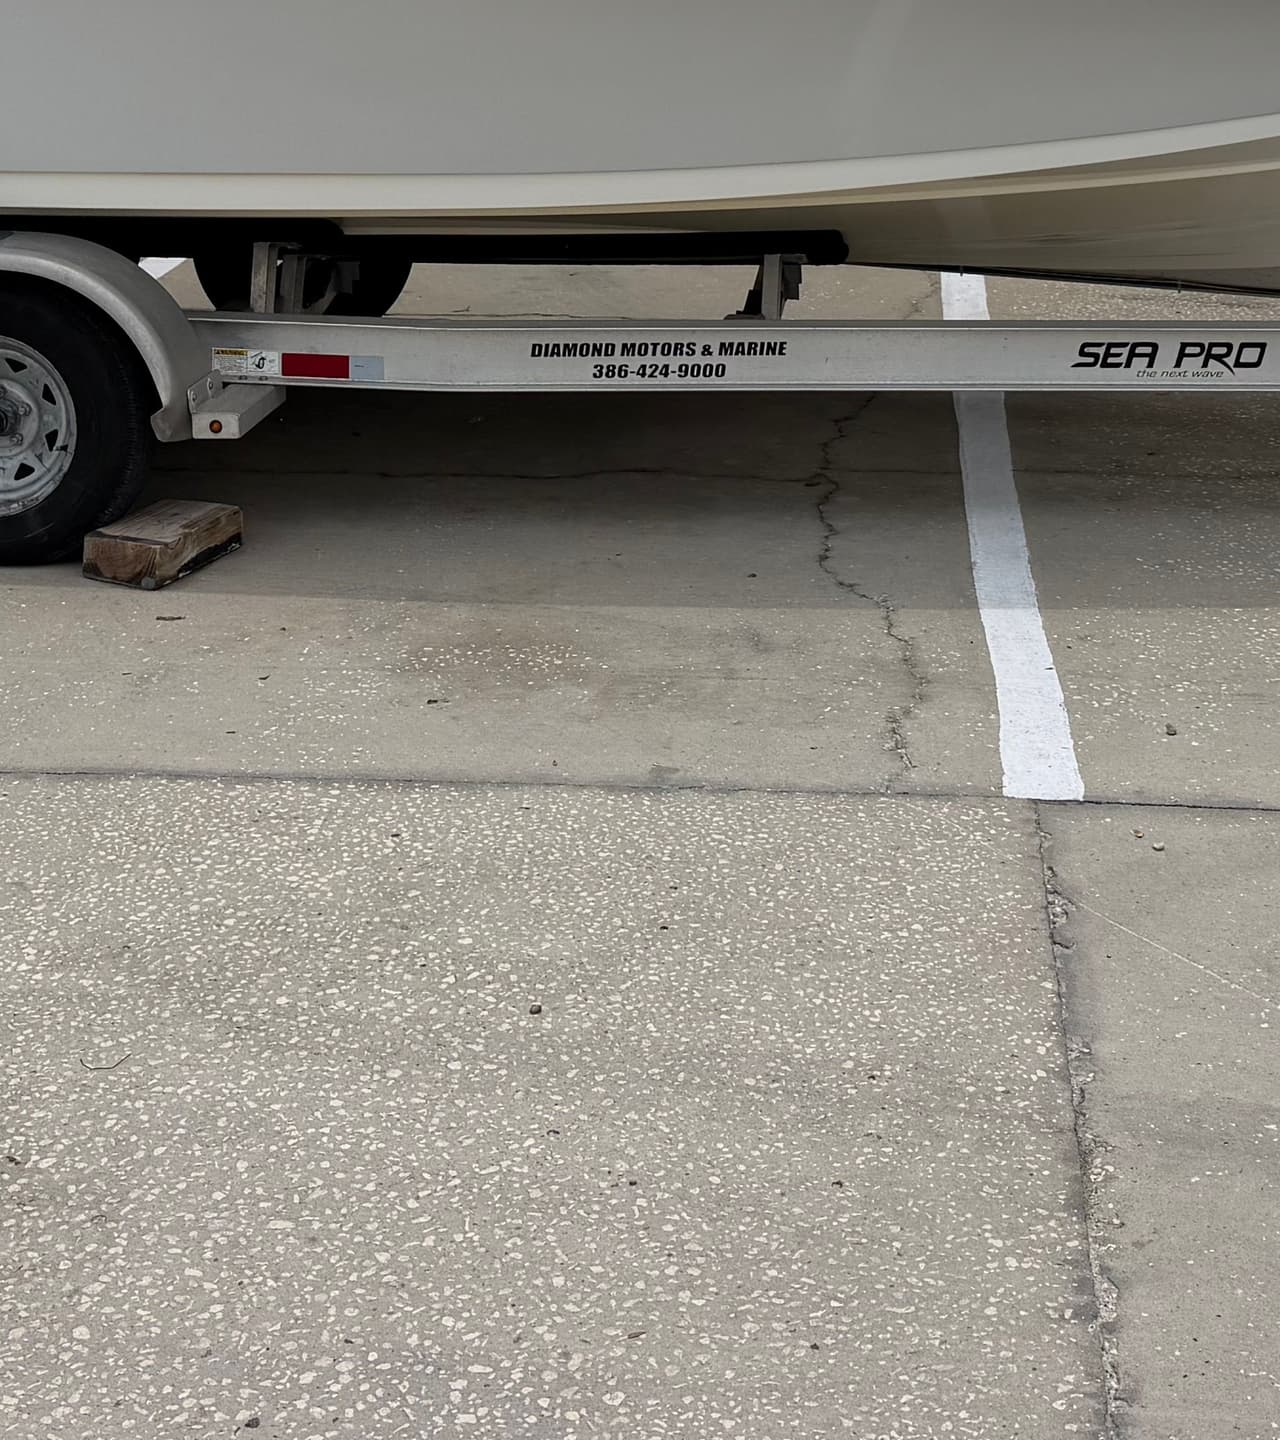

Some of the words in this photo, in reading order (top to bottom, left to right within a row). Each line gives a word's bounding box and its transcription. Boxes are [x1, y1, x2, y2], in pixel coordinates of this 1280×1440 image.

[530, 342, 616, 358] DIAMOND
[620, 341, 697, 358] MOTORS
[700, 343, 714, 356] &
[718, 341, 788, 357] MARINE
[1070, 342, 1159, 369] SEA
[1173, 342, 1268, 376] PRO
[592, 363, 727, 379] 386-424-9000
[1136, 369, 1156, 378] the
[1160, 369, 1189, 378] next
[1192, 370, 1224, 378] wave
